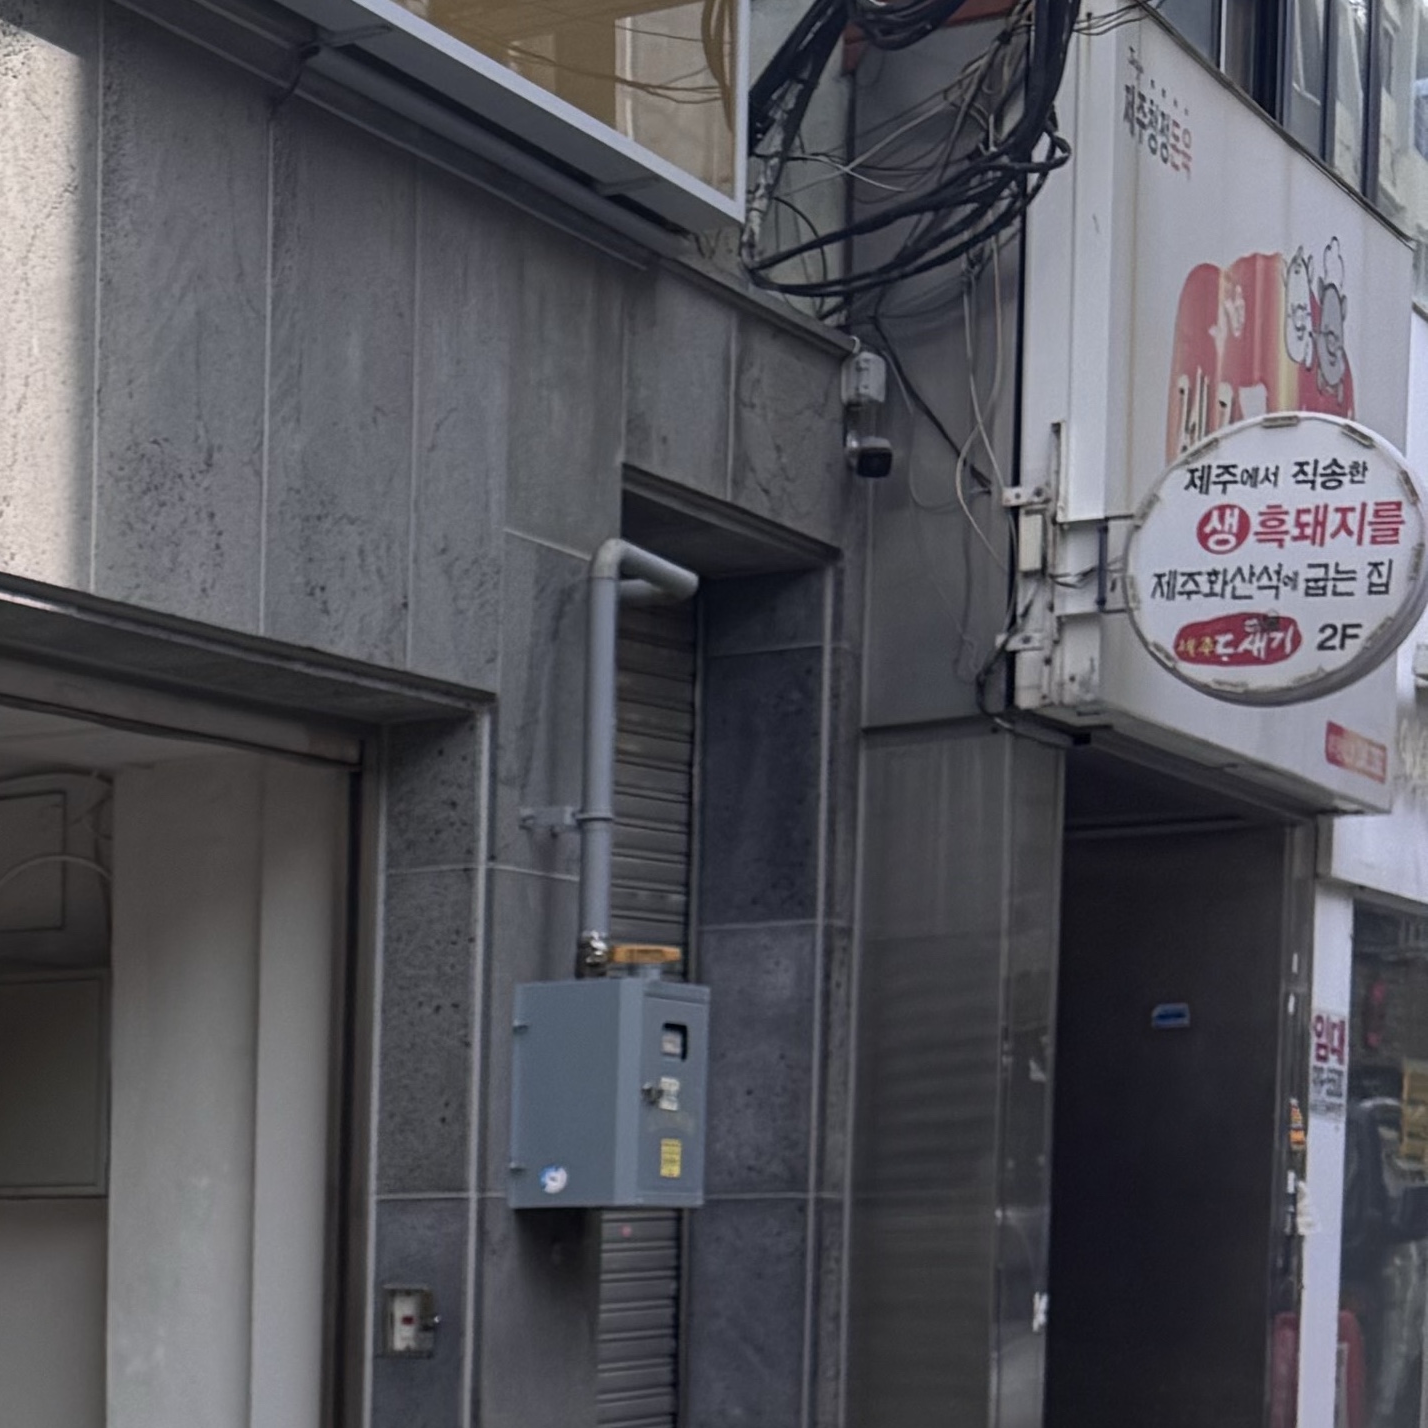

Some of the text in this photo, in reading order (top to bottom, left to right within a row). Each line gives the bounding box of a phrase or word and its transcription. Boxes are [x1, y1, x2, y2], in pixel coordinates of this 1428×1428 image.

[1183, 457, 1369, 495] 제주에서 직송한
[1202, 500, 1406, 550] 생 흑돼지를
[1150, 557, 1393, 600] 제주화산석에 굽는 집
[1316, 623, 1363, 652] 2F
[1313, 1014, 1345, 1066] 임대
